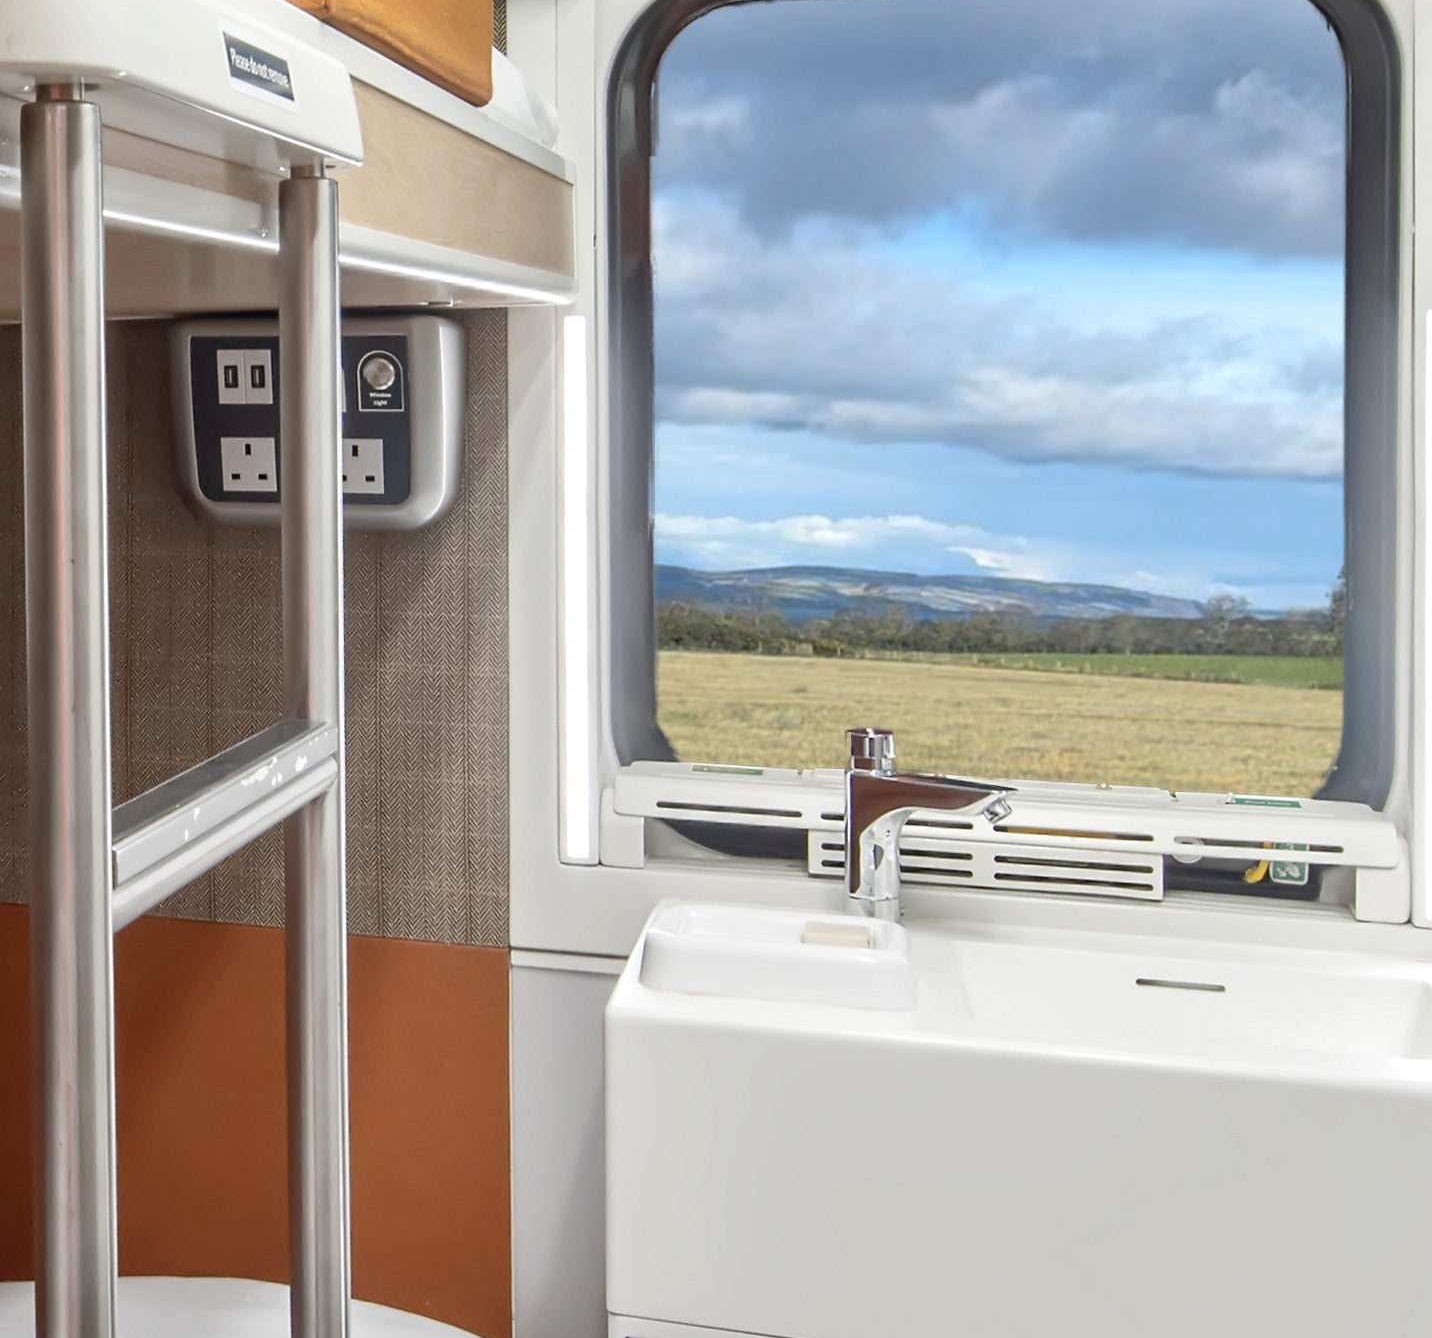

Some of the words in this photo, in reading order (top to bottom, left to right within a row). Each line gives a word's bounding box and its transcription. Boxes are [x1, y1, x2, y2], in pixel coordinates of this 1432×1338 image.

[230, 47, 250, 72] Please
[250, 55, 258, 75] do
[258, 63, 268, 79] not
